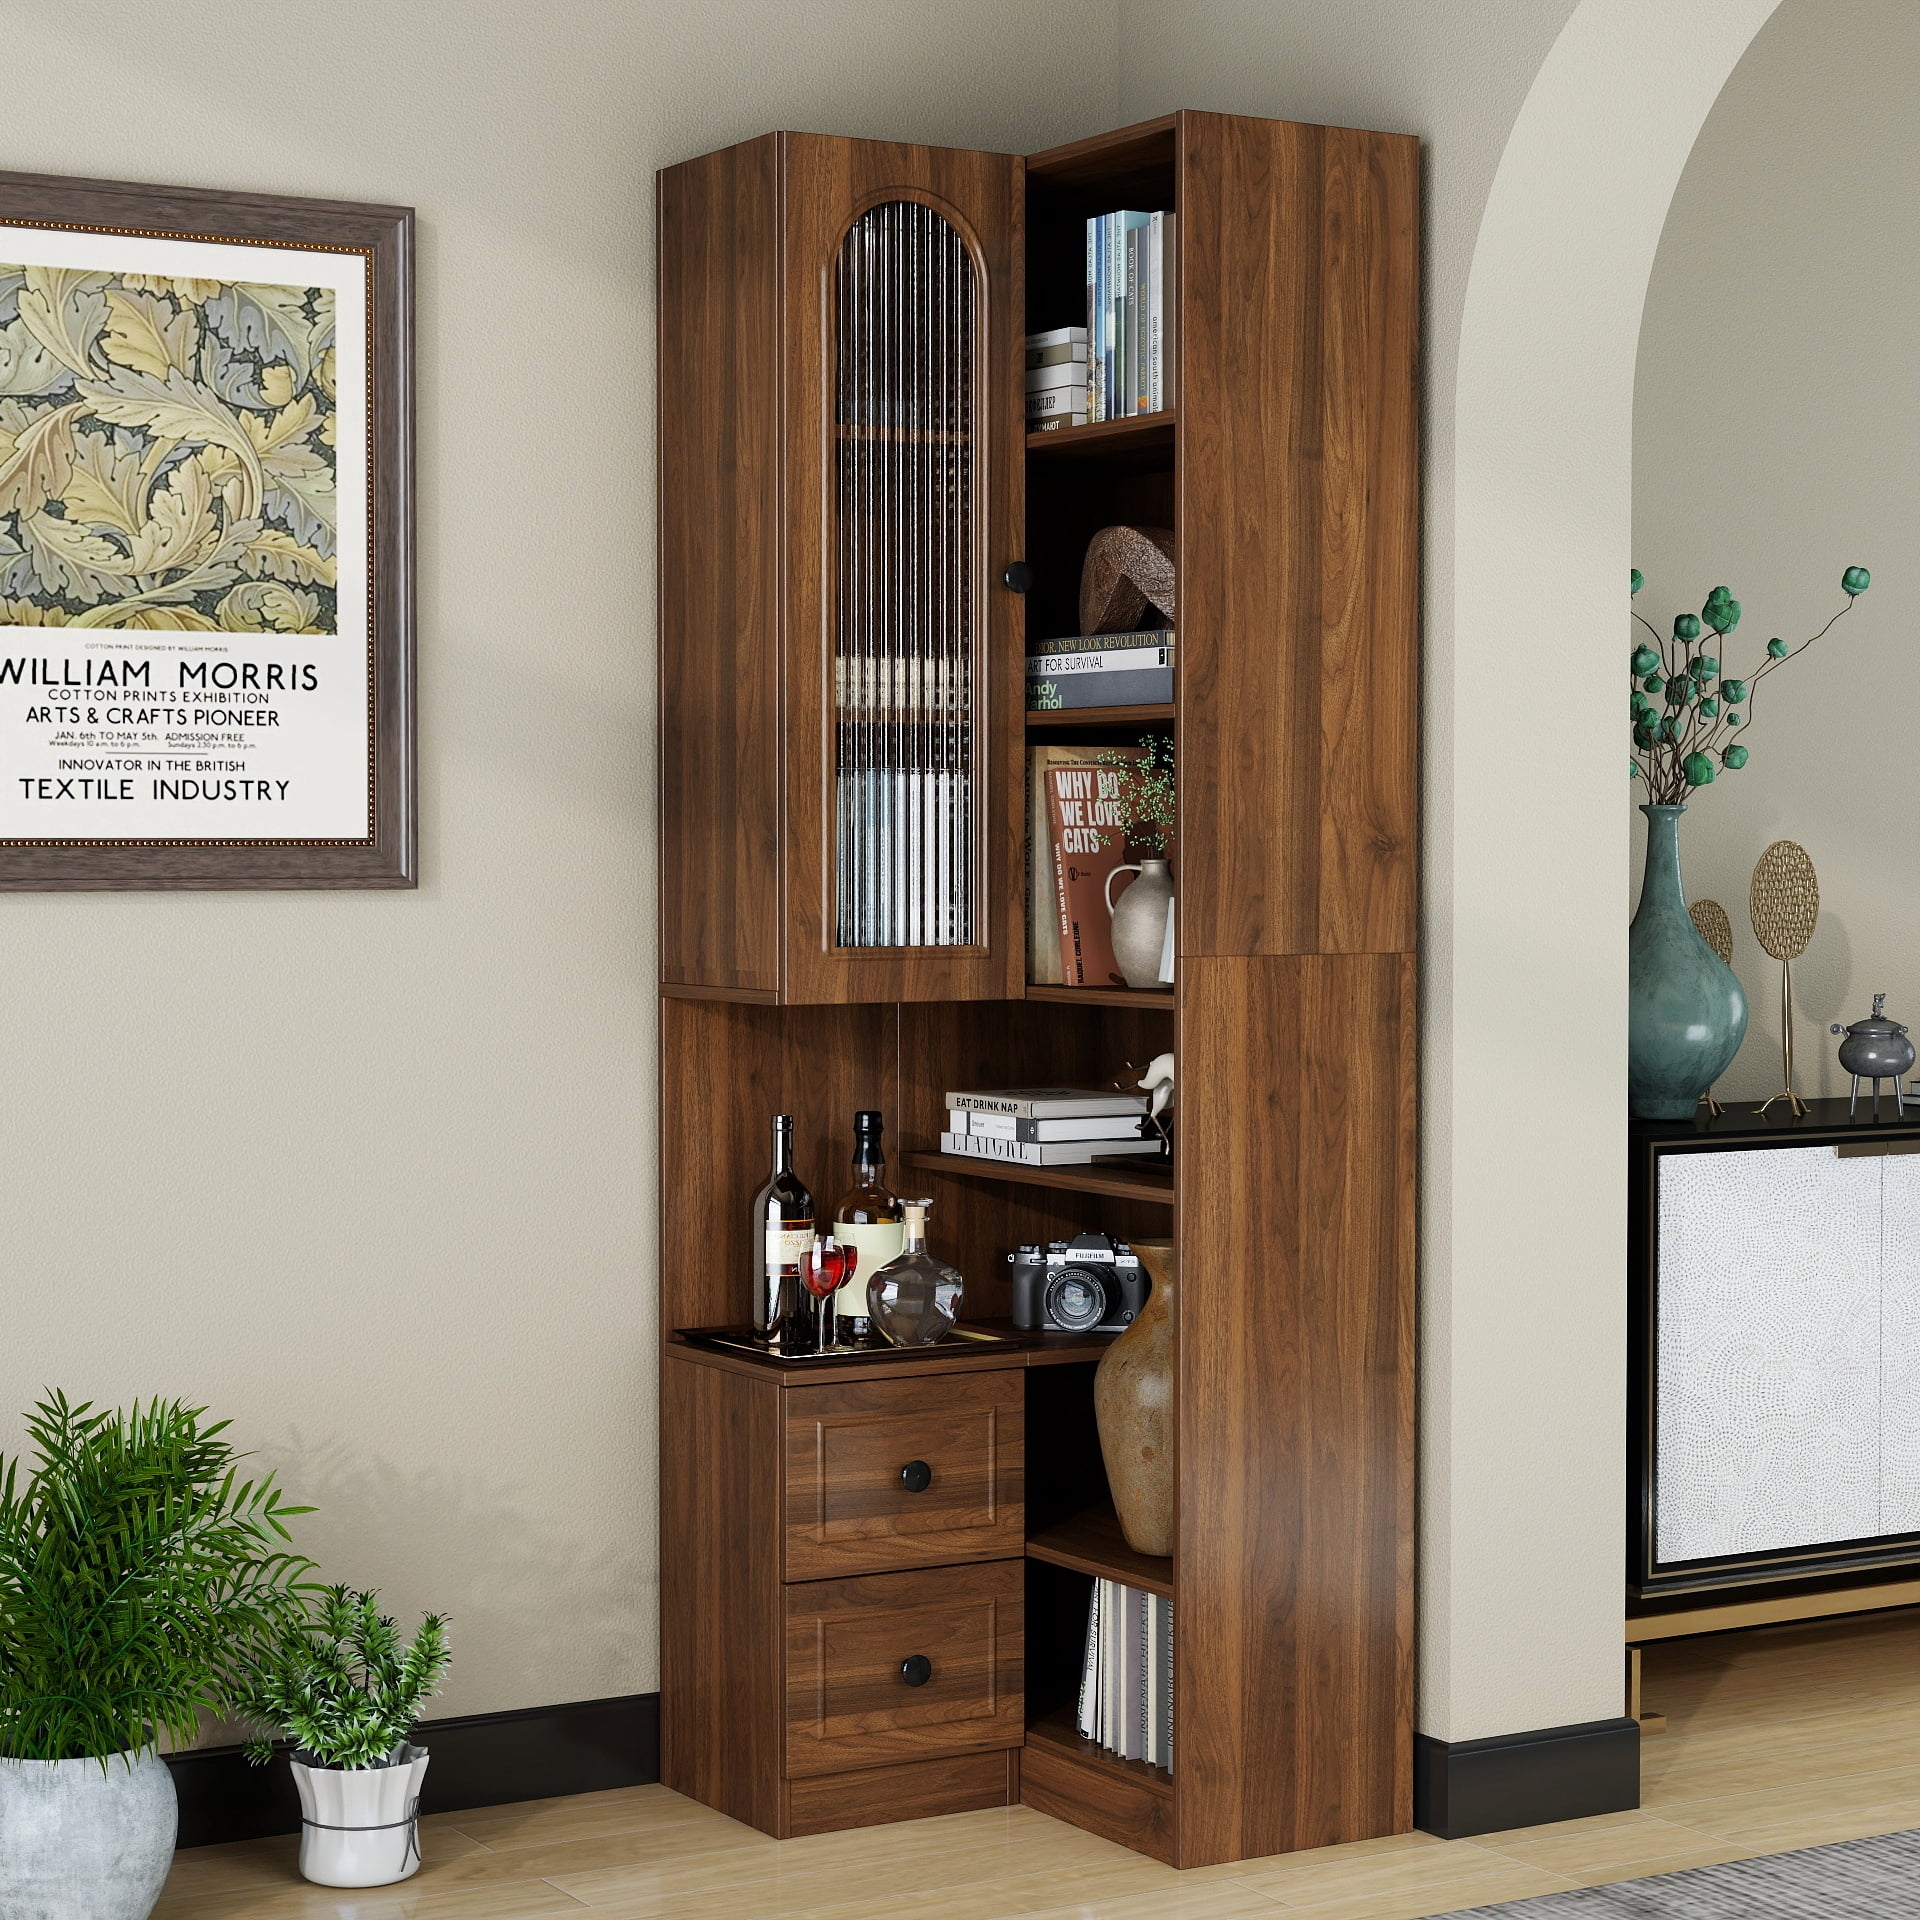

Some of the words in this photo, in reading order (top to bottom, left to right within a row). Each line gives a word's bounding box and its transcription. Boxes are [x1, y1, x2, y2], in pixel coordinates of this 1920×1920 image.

[1128, 272, 1135, 282] OF
[1058, 640, 1077, 652] NEW
[1079, 638, 1102, 651] LOOK
[1103, 633, 1159, 649] REVOLUTION
[1027, 659, 1043, 673] ART
[1045, 658, 1063, 672] FOR
[1064, 655, 1104, 671] SURVIVAL
[0, 658, 149, 687] WILLIAM
[180, 662, 318, 691] MORRIS
[48, 689, 117, 701] COTTON
[124, 690, 177, 703] PRINTS
[183, 691, 269, 704] EXHIBITION
[1026, 680, 1057, 698] Andy
[1027, 695, 1063, 710] arhol
[26, 706, 80, 724] ARTS
[87, 707, 99, 724] &
[106, 707, 188, 726] CRAFTS
[194, 709, 280, 727] PIONEER
[79, 731, 96, 741] 6th
[99, 731, 114, 740] TO
[116, 732, 138, 741] MAY
[165, 732, 219, 741] ADMISSION
[221, 733, 245, 742] FREE
[59, 759, 142, 771] INNOVATOR
[147, 760, 162, 771] IN
[166, 760, 192, 772] THE
[196, 760, 245, 772] BRITISH
[19, 778, 134, 800] TEXTILE
[153, 779, 290, 801] INDUSTRY
[1056, 771, 1092, 799] WHY
[1096, 771, 1120, 799] DO
[1059, 801, 1085, 827] WE
[1086, 801, 1124, 827] LOVE
[1062, 828, 1100, 854] CATS
[1058, 878, 1064, 893] WE
[1072, 921, 1082, 957] CORLEONE
[956, 1097, 971, 1108] EAT
[973, 1099, 999, 1112] DRINK
[1001, 1103, 1018, 1113] NAP
